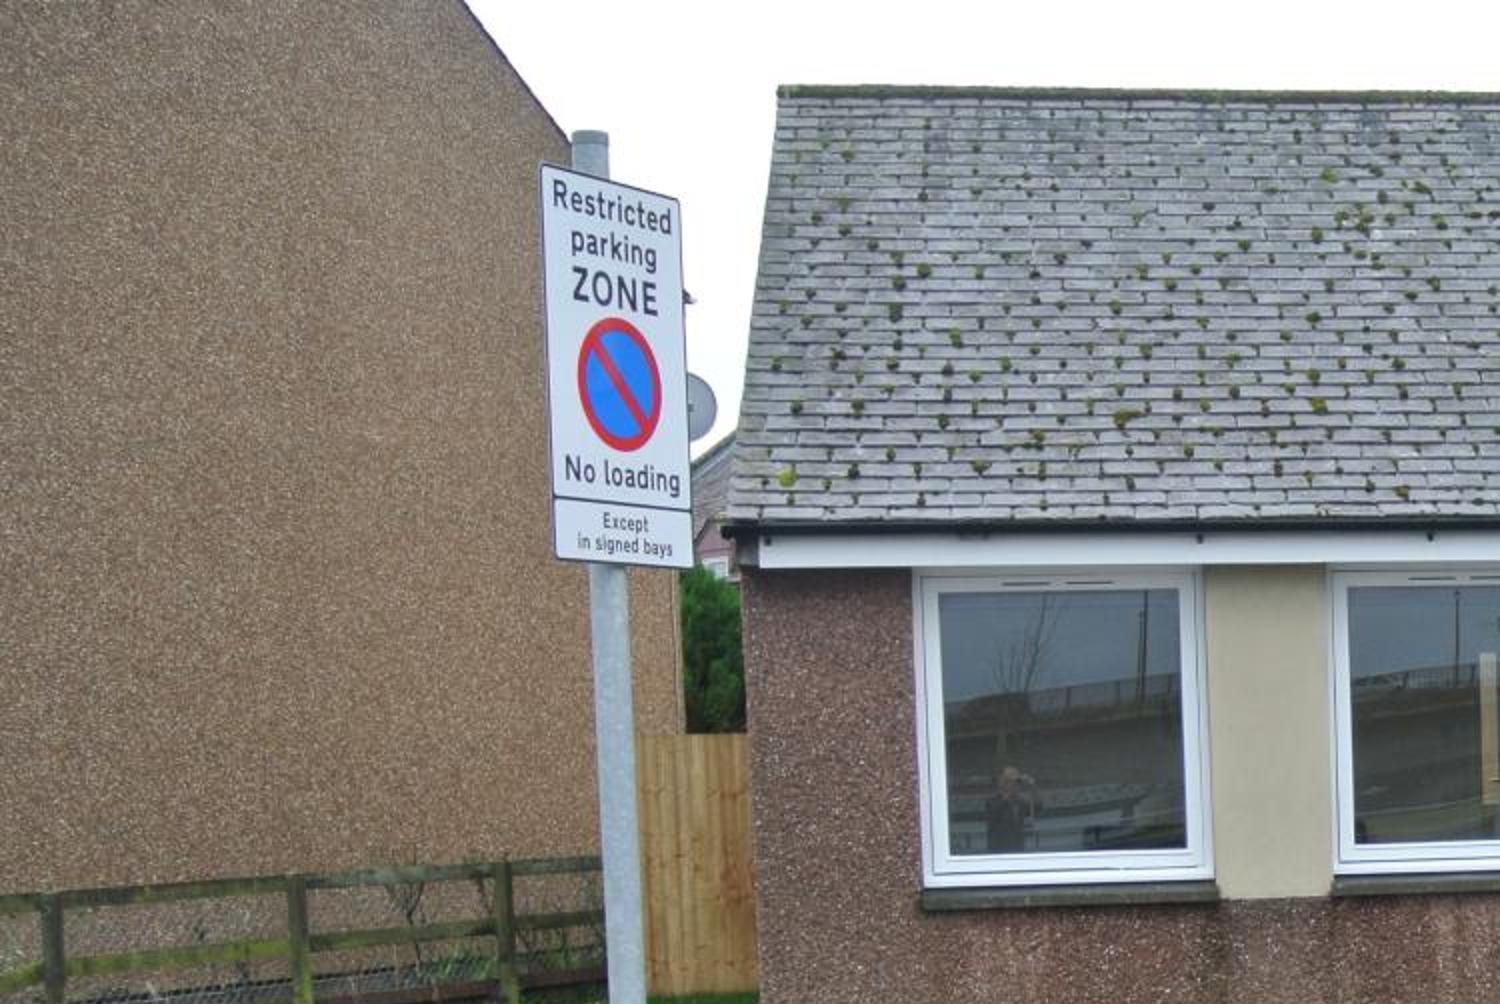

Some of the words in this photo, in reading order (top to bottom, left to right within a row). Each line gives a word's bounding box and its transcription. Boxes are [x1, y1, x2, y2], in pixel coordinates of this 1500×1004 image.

[553, 179, 671, 234] Restricted
[571, 230, 657, 274] parking
[572, 265, 658, 316] ZONE
[565, 454, 595, 483] No
[604, 459, 680, 498] loading
[577, 531, 591, 551] in
[595, 533, 639, 555] signed
[643, 538, 673, 558] bays
[603, 512, 649, 534] Except
